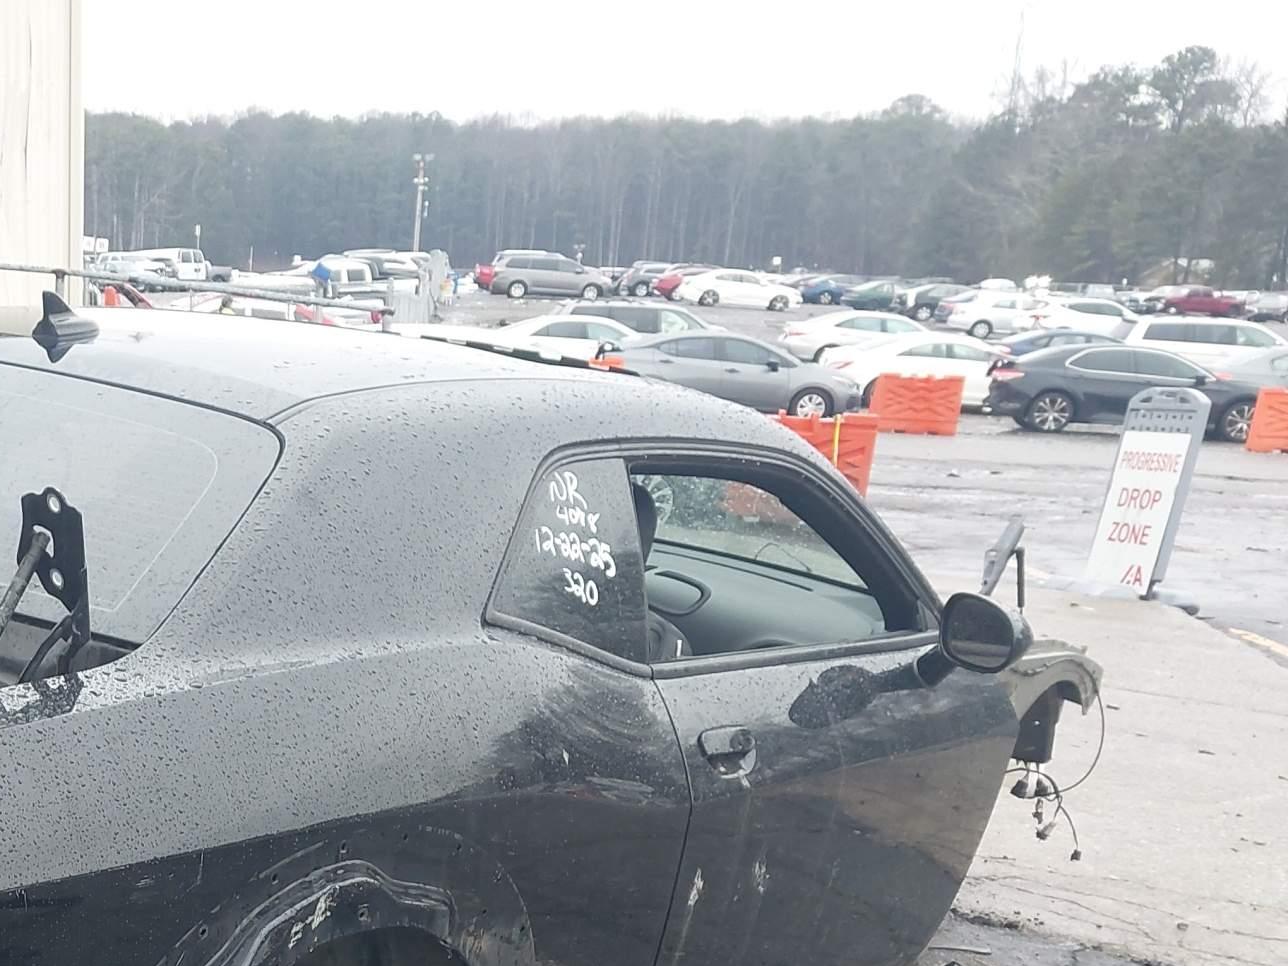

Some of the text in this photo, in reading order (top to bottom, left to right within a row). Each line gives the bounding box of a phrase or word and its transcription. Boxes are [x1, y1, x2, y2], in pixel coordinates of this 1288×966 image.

[1121, 450, 1182, 473] PROGRESSIVE
[549, 471, 587, 509] NR
[1117, 487, 1162, 510] DROP
[1107, 521, 1152, 546] ZONE
[535, 526, 616, 577] 12-22-25
[562, 567, 599, 606] 320
